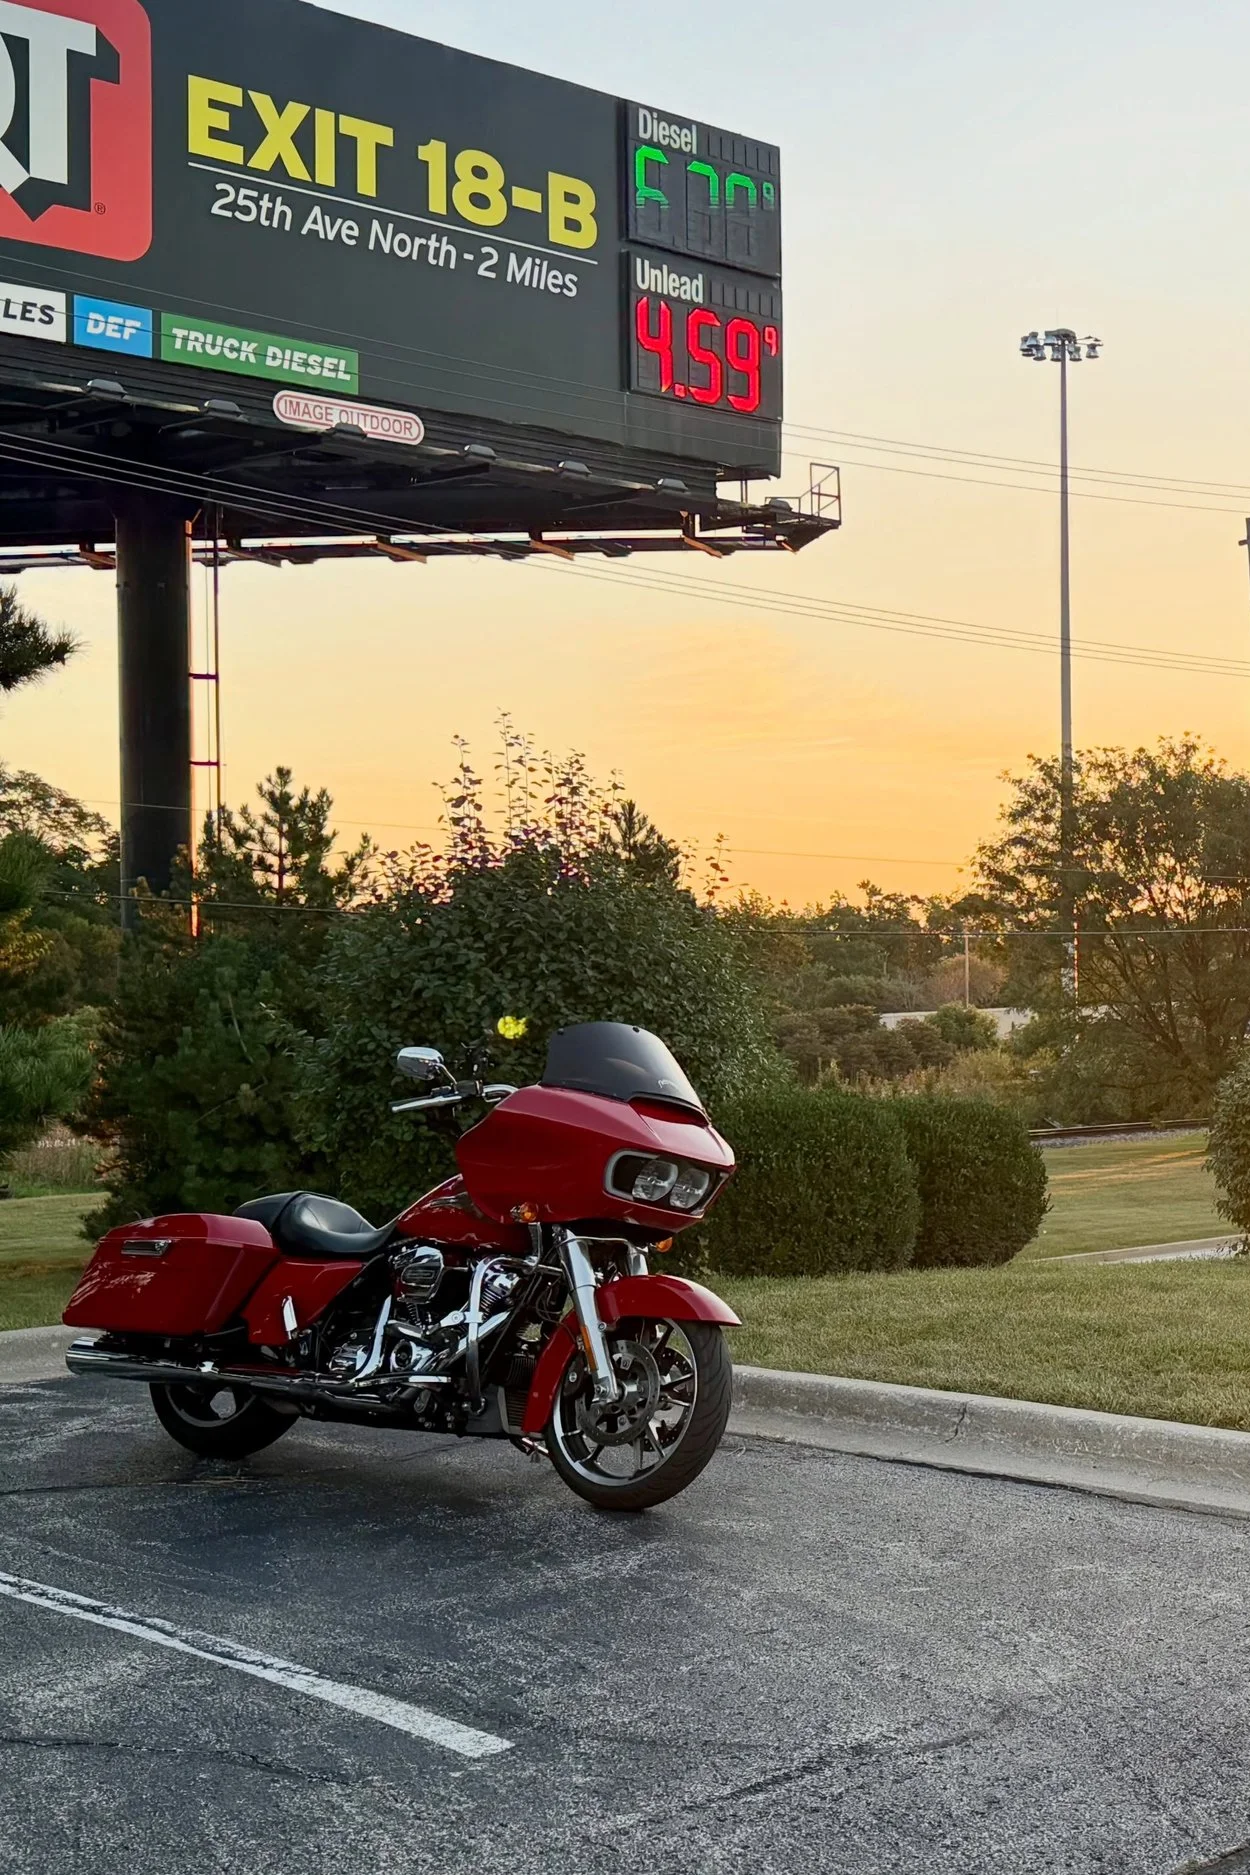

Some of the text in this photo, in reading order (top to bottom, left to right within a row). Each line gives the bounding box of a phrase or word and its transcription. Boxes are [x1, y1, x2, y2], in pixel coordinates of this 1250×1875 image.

[0, 0, 97, 195] T
[638, 107, 698, 155] Diesel
[188, 75, 598, 250] EXIT 18-B
[210, 182, 292, 232] 25th
[301, 205, 360, 247] Ave
[506, 252, 578, 298] Miles
[636, 257, 704, 304] Unlead
[3, 298, 56, 325] LES
[86, 312, 142, 341] DEF
[172, 327, 351, 381] TRUCK DIESEL
[283, 398, 414, 437] IMAGE OUTDOOR
